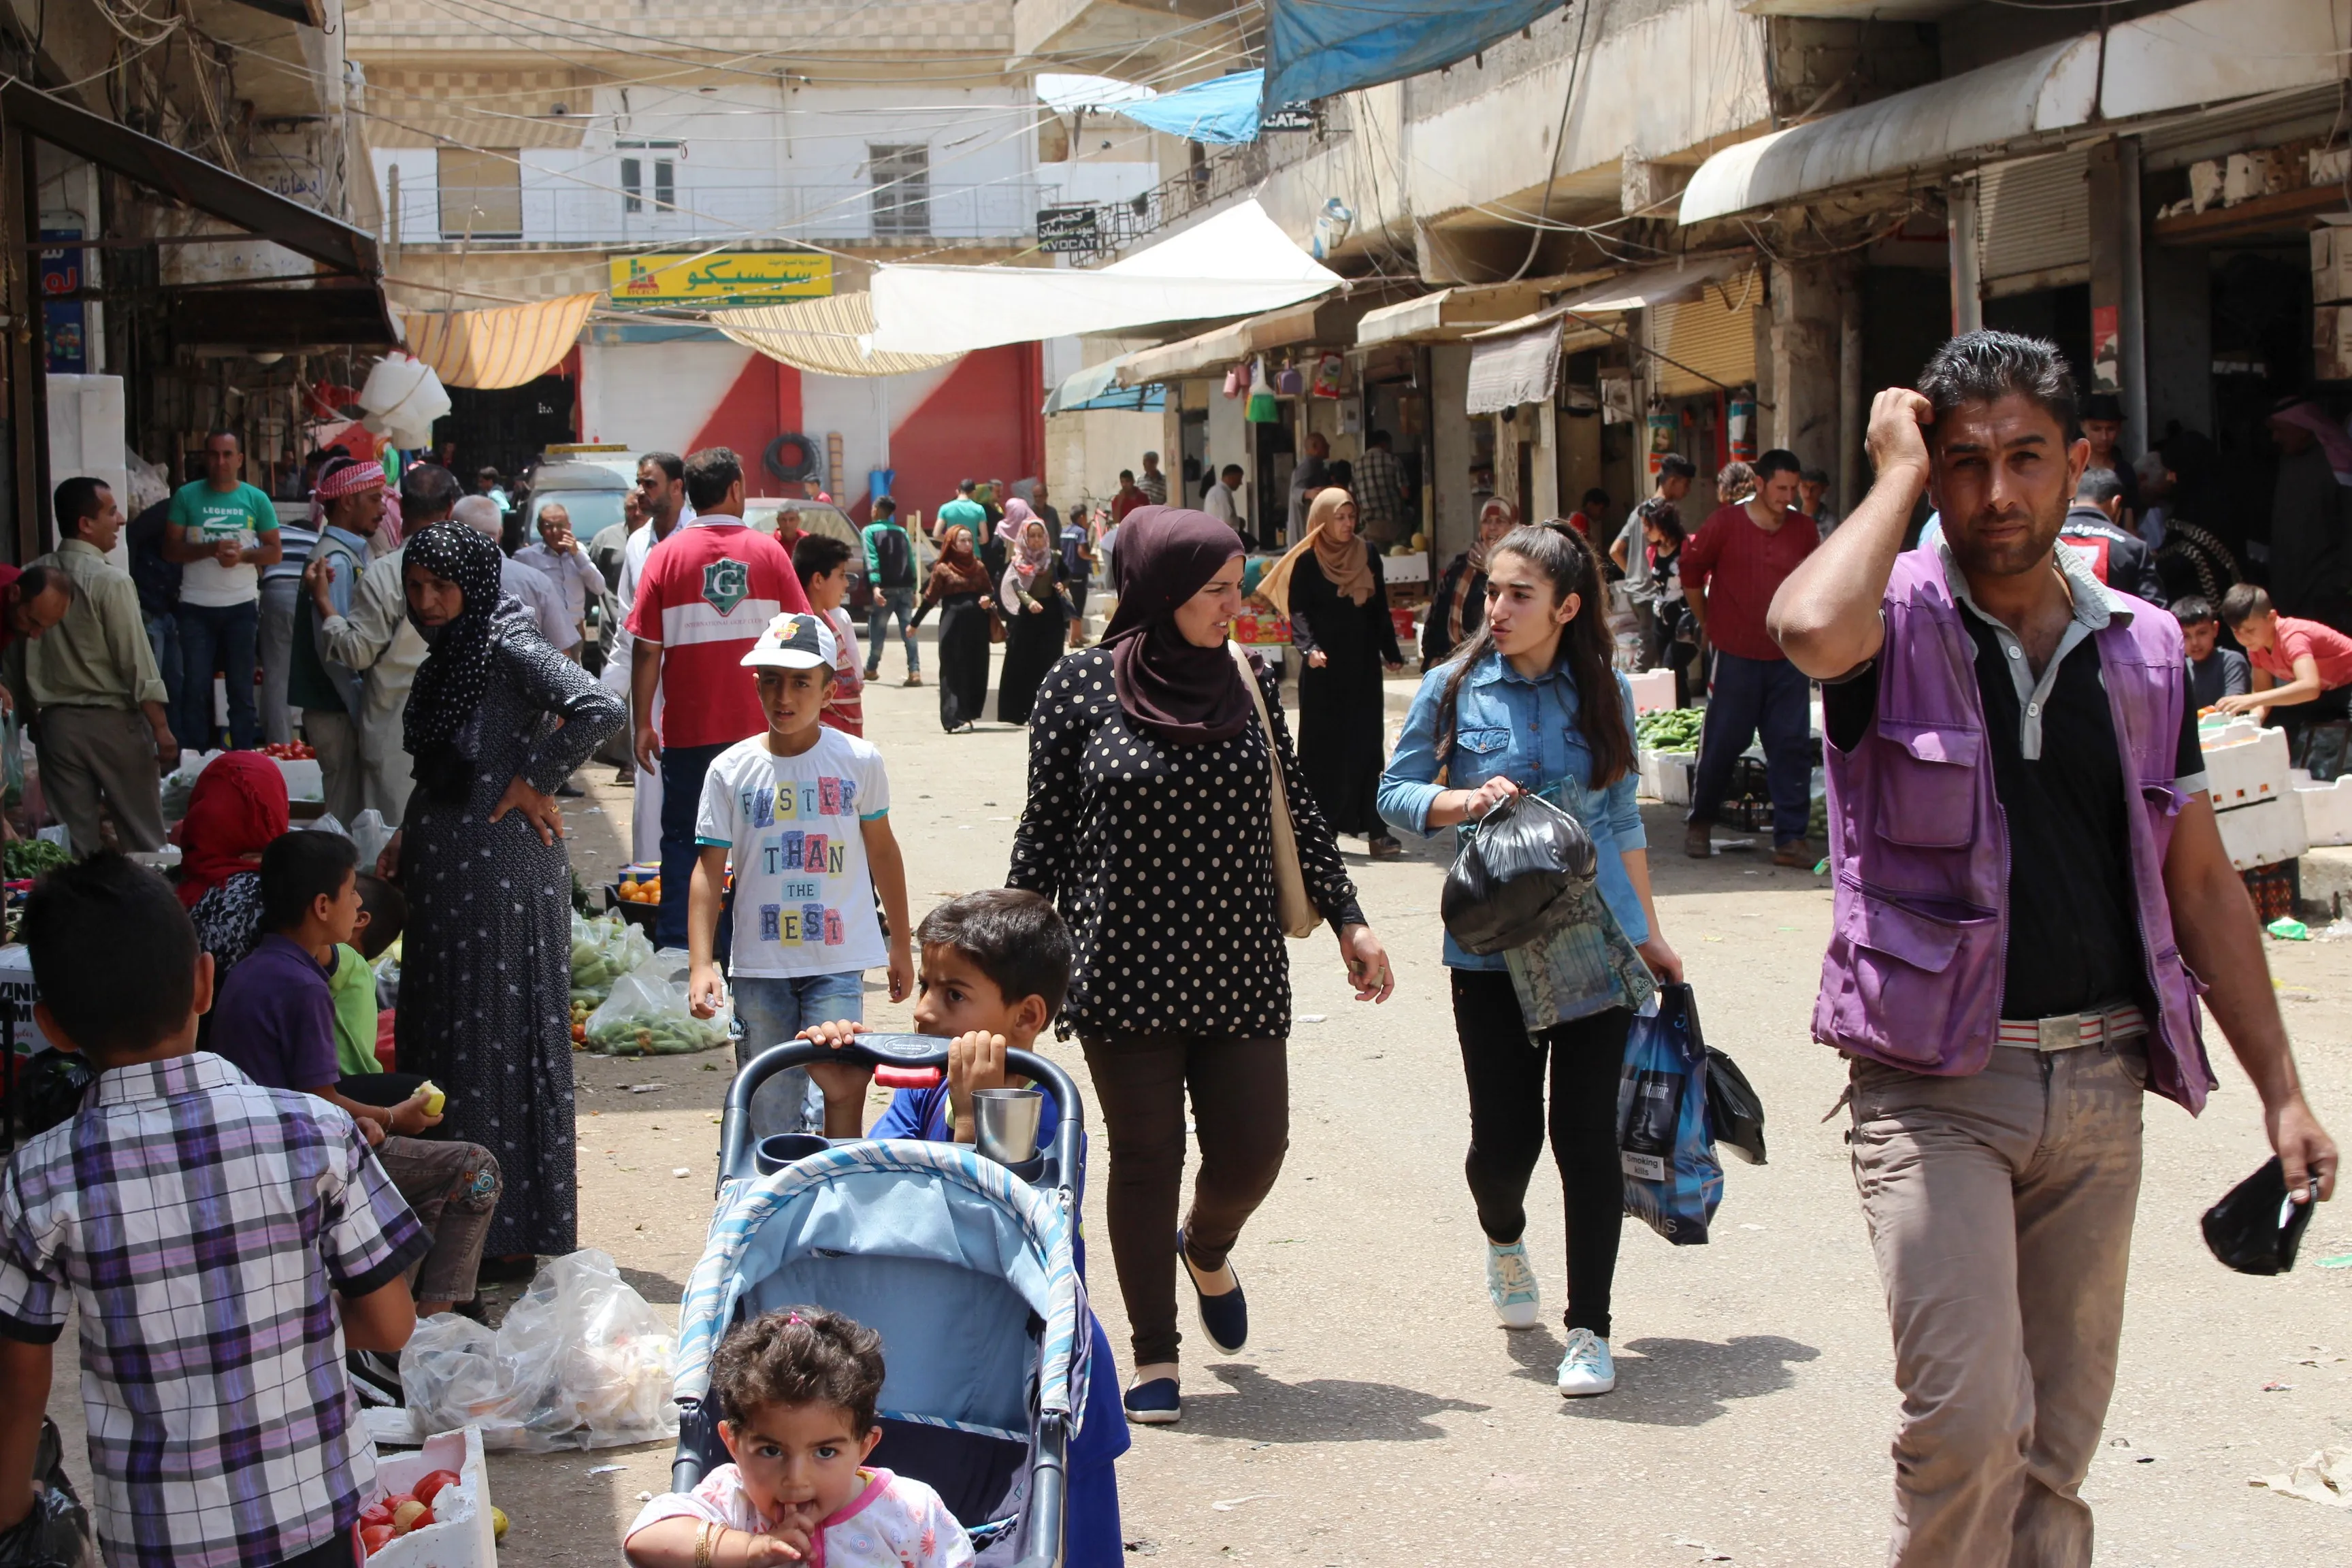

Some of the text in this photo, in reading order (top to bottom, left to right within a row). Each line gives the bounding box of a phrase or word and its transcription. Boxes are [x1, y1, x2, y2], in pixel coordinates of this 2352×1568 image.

[1042, 238, 1095, 252] AVOCAT
[203, 507, 244, 516] LEGENDE
[713, 570, 740, 596] G
[684, 619, 728, 628] INTERNATIONAL
[747, 615, 763, 624] CLUB
[742, 784, 854, 819] FASTER
[764, 839, 844, 874] THAN
[787, 884, 815, 897] THE
[764, 911, 840, 941] REST
[1627, 1154, 1659, 1169] Smoking
[1634, 1166, 1650, 1176] kills
